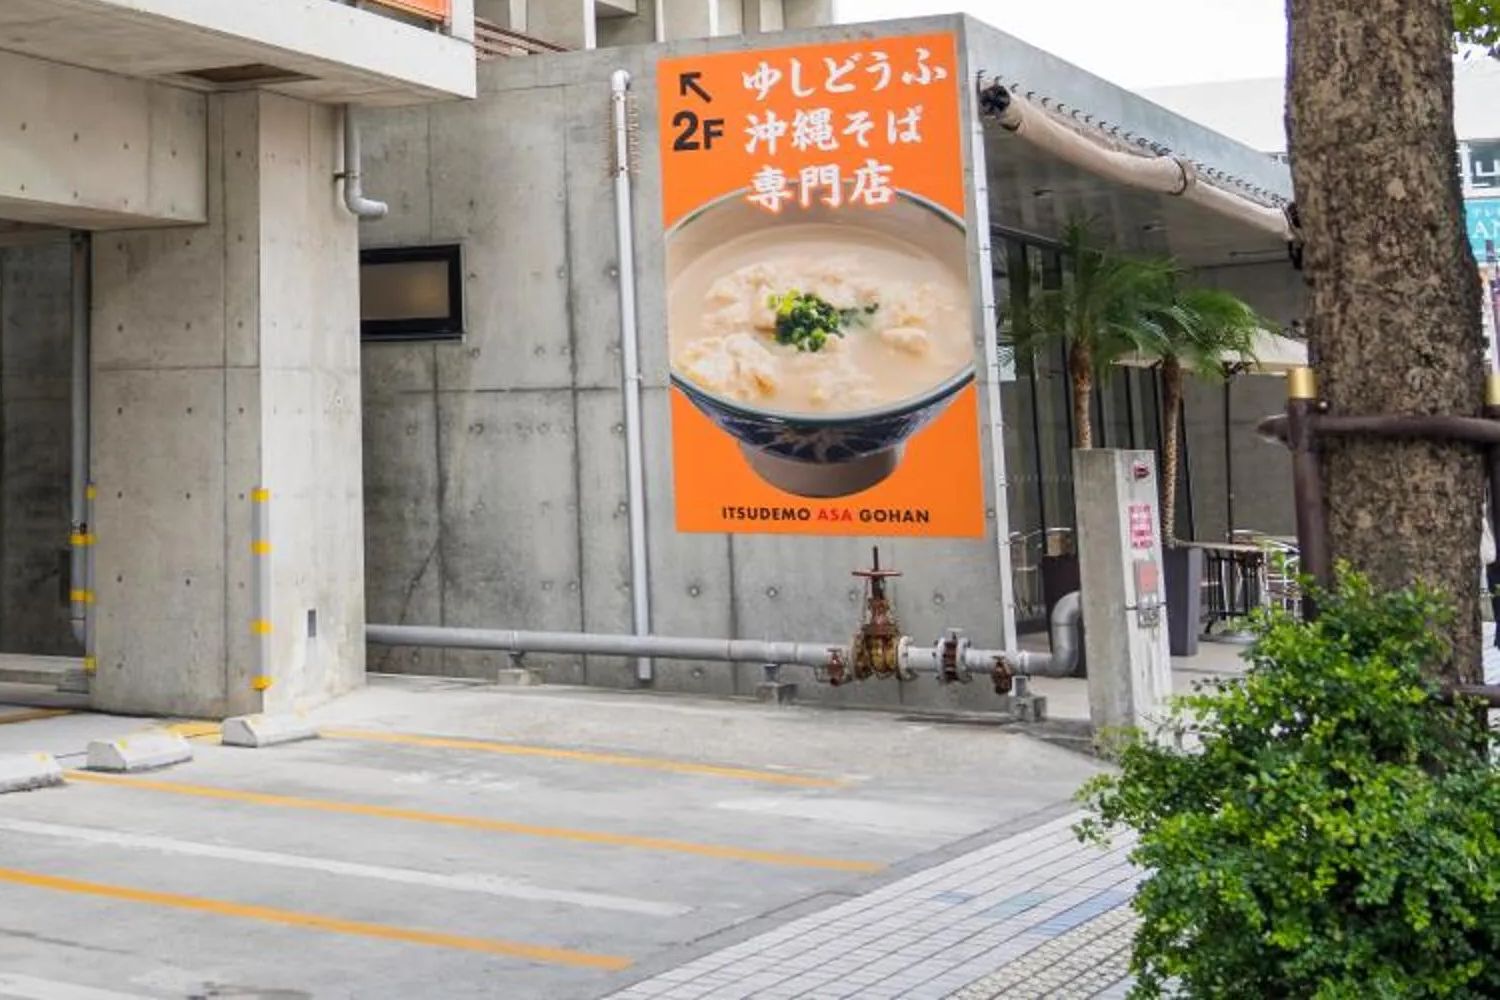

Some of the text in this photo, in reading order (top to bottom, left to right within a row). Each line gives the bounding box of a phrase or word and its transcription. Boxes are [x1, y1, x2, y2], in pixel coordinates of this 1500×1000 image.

[741, 48, 947, 101] ゆしどうふ
[673, 111, 724, 151] 2F
[744, 105, 923, 154] 沖縄そば
[748, 158, 895, 213] 専門店
[722, 506, 930, 523] ITSUDEMO ASA GOHAN
